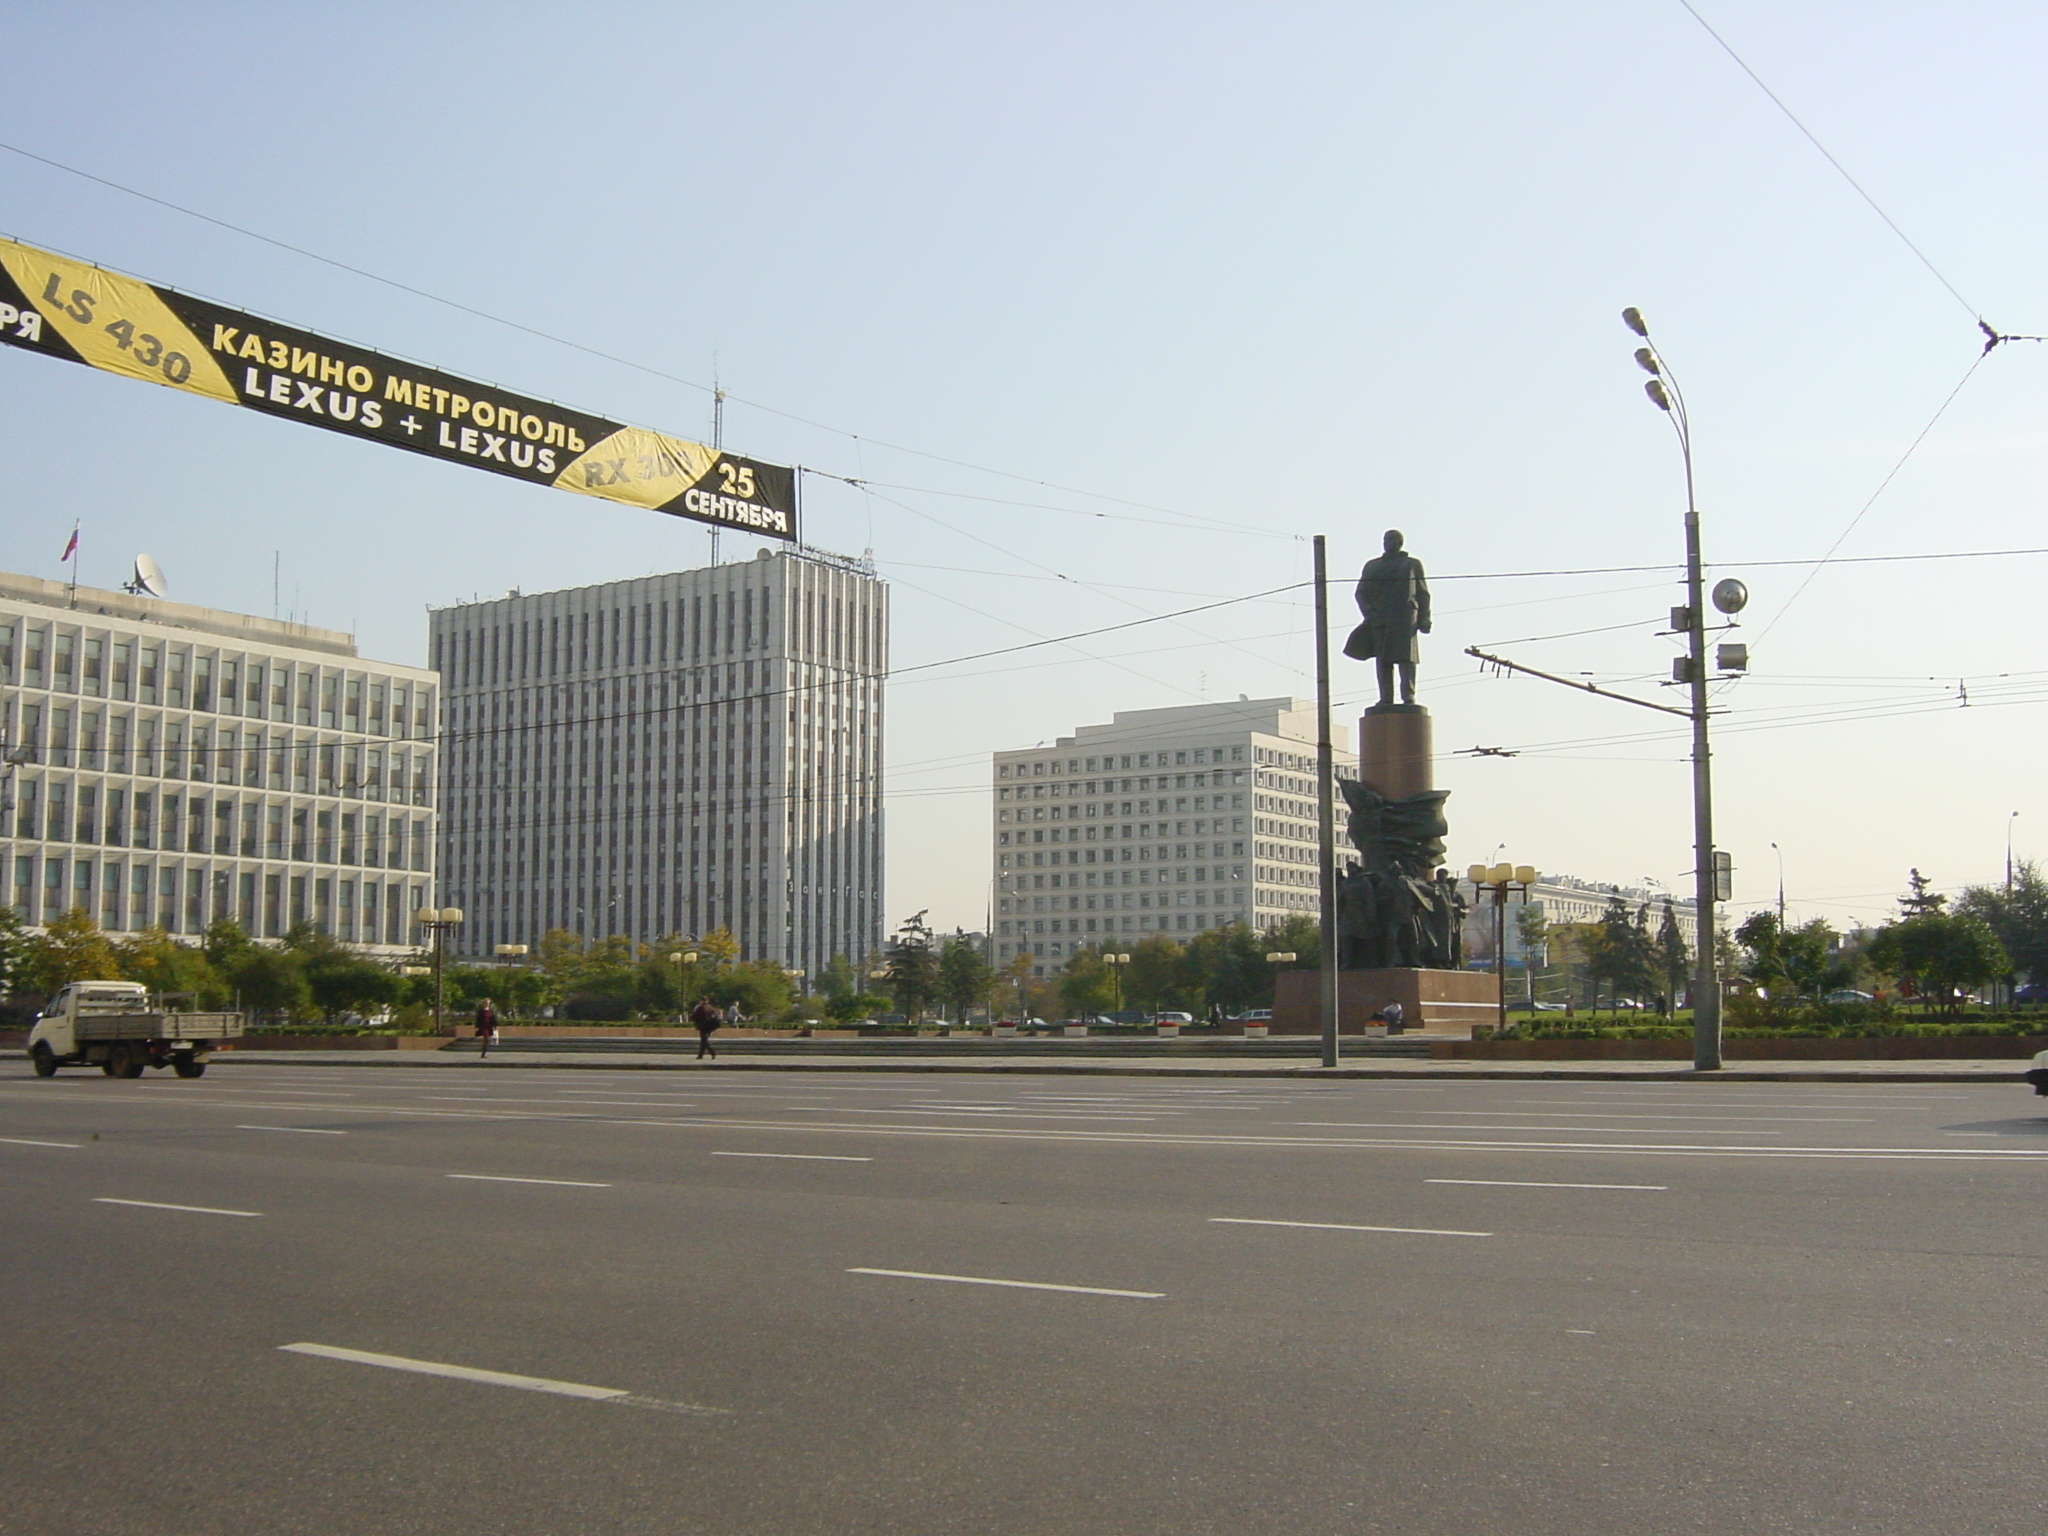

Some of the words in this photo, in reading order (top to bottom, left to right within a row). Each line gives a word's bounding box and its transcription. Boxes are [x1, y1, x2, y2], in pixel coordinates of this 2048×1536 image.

[43, 273, 97, 324] LS
[105, 318, 193, 385] 430
[213, 323, 374, 393] КАЗИНО
[384, 375, 586, 452] МЕТРОПОЛЬ
[246, 367, 383, 429] LEXUS
[400, 415, 422, 436] +
[439, 421, 556, 474] LEXUS
[584, 458, 631, 487] RX
[684, 488, 788, 532] СЕНТЯБРЯ
[719, 462, 755, 498] 25
